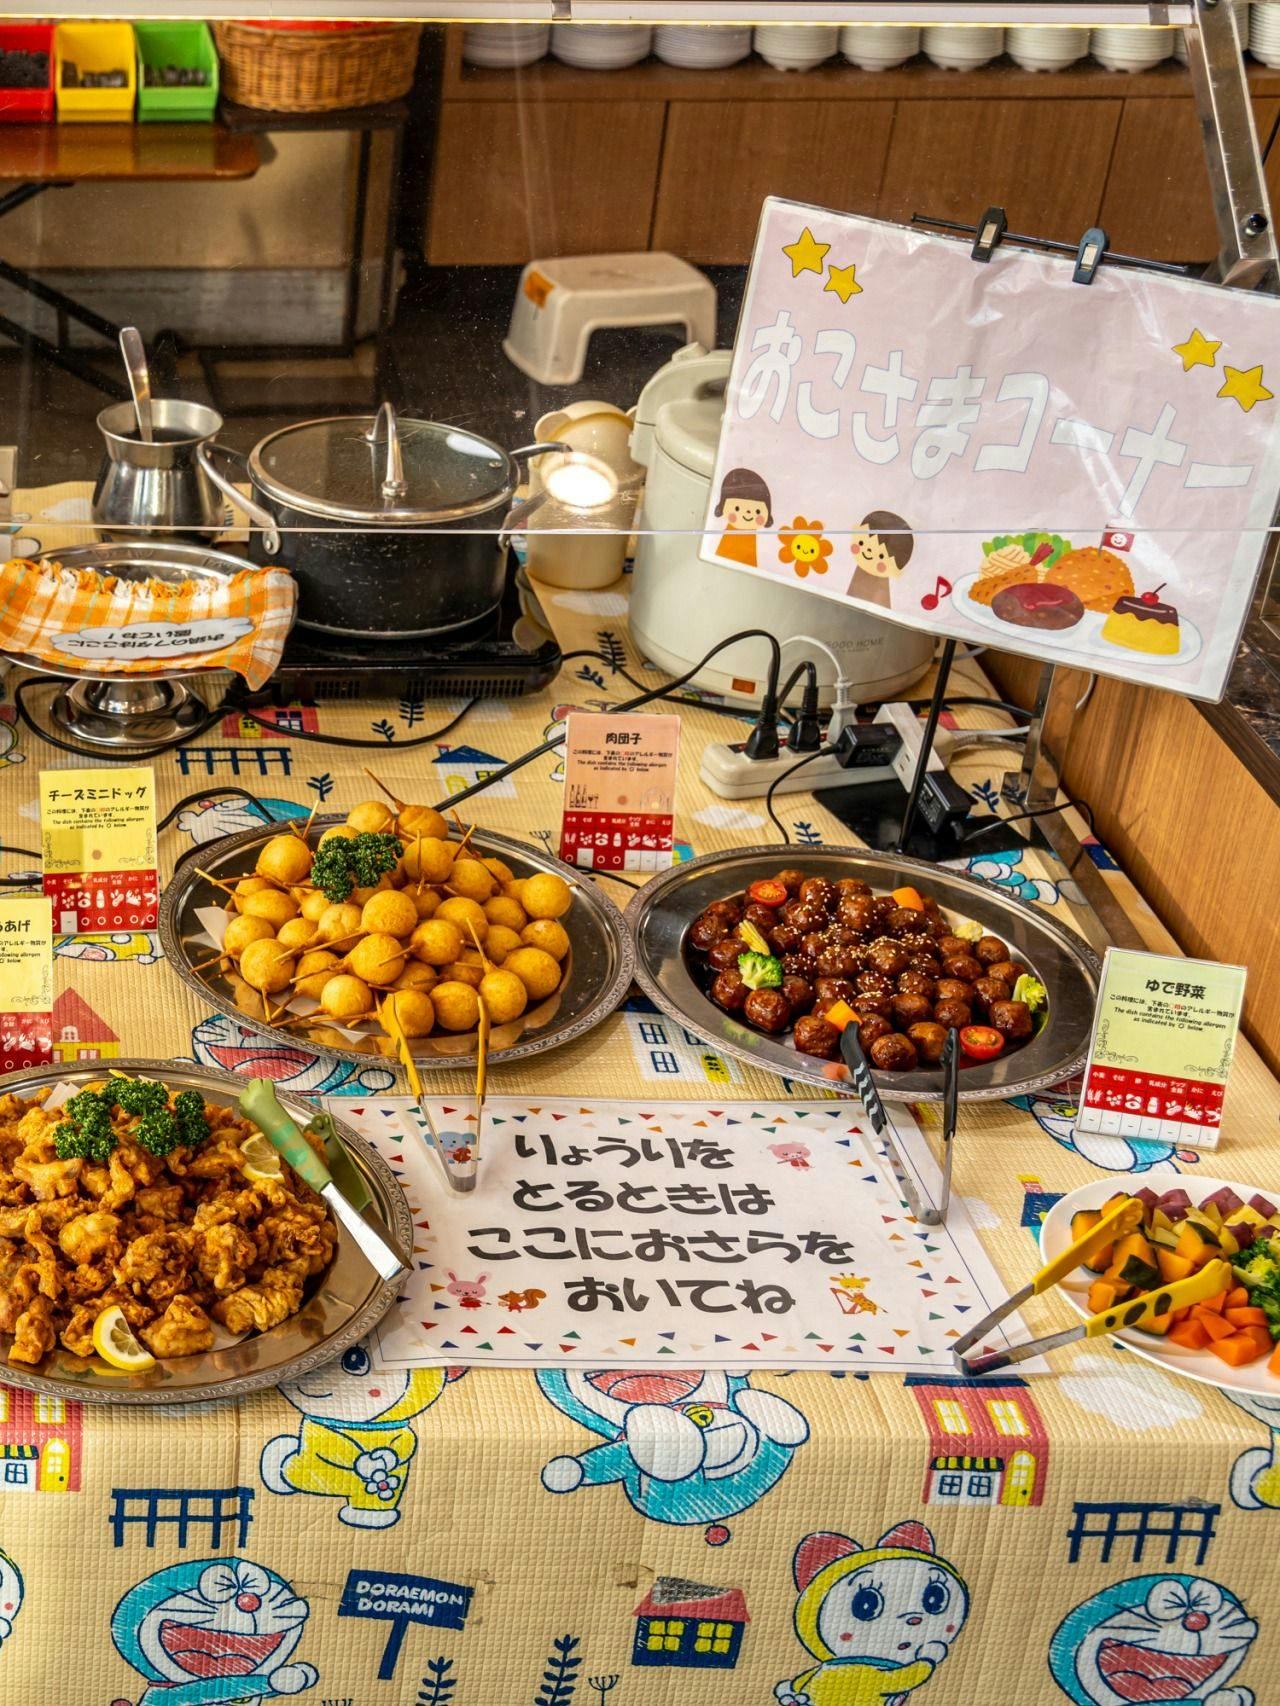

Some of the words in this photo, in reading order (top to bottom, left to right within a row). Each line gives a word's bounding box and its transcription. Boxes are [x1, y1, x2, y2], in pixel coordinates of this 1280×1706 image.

[738, 310, 1255, 519] おこさまコーナー
[606, 733, 642, 745] 肉団子
[49, 786, 147, 801] チーズミニドッグ
[1146, 980, 1206, 999] ゆで野菜
[514, 1134, 735, 1170] りょうりを
[512, 1179, 776, 1215] とるときは
[466, 1227, 855, 1264] ここにおさらを
[564, 1276, 796, 1314] おいてね
[356, 1581, 464, 1605] DORAEMON
[358, 1598, 434, 1617] DORAMI
